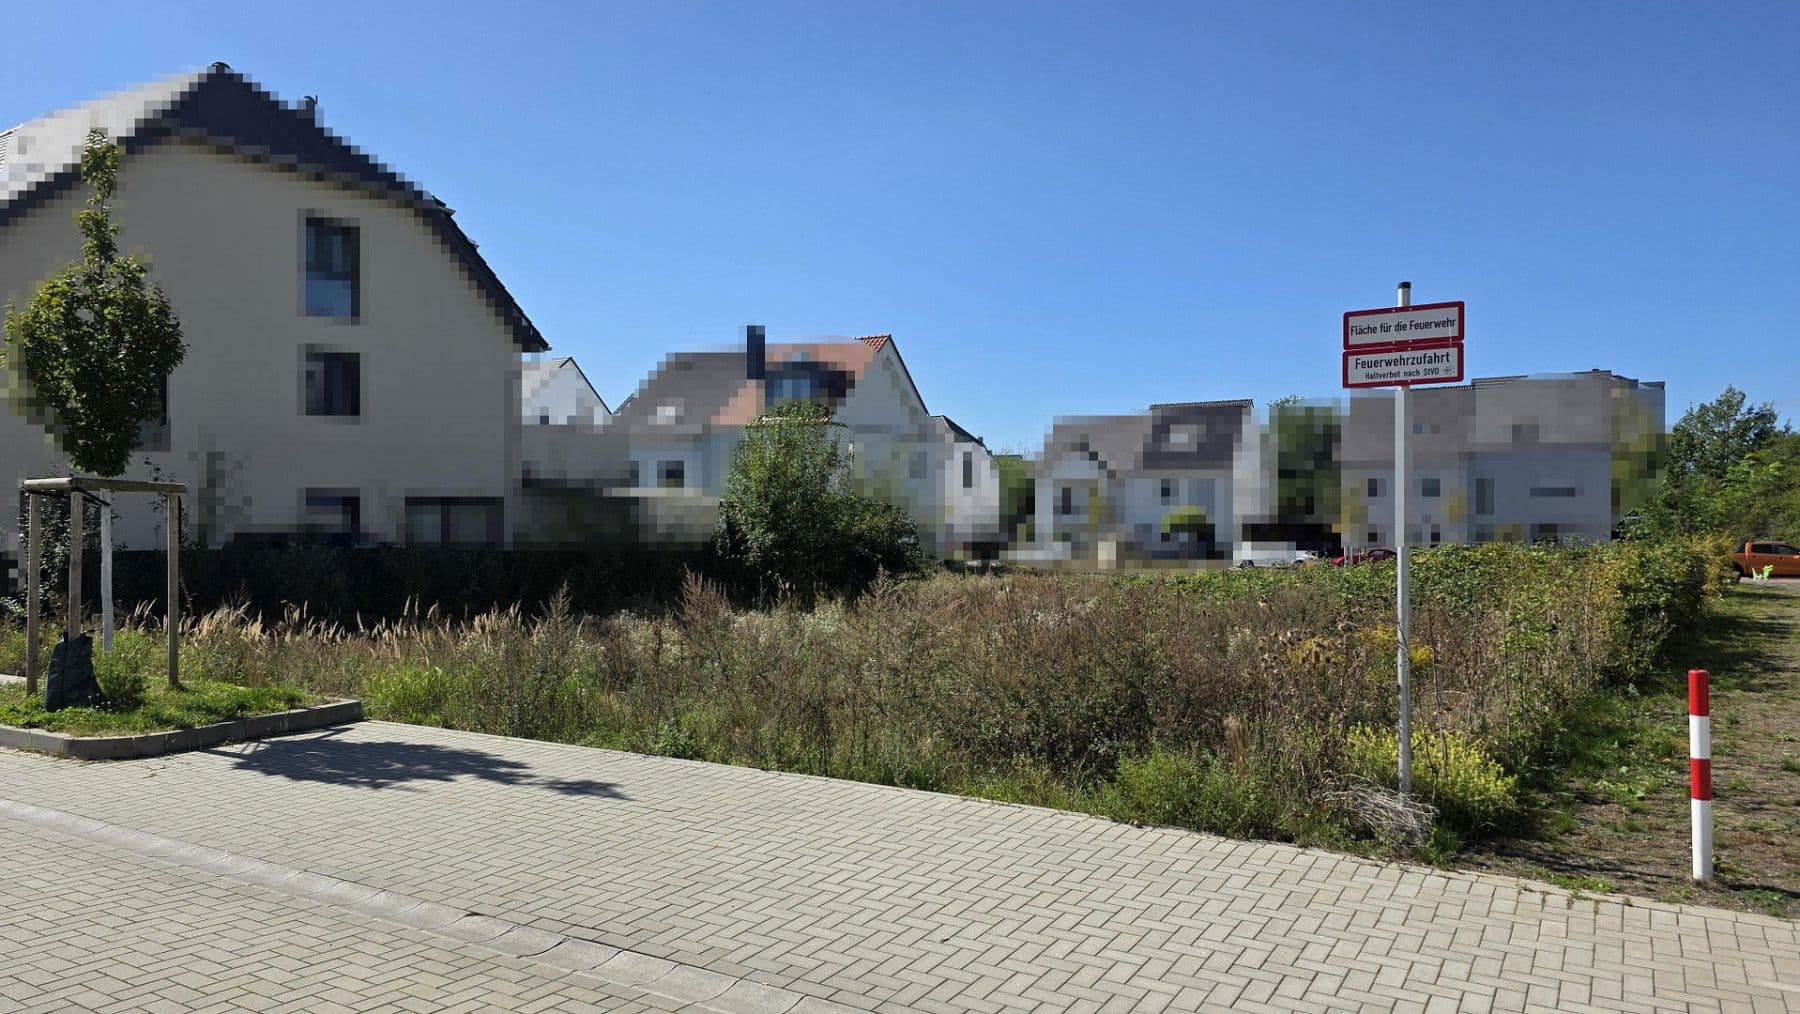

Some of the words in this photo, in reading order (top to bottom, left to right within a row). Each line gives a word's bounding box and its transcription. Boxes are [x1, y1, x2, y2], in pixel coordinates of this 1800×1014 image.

[1350, 324, 1378, 336] Fläche
[1380, 322, 1392, 333] für
[1394, 321, 1407, 332] die
[1409, 317, 1457, 331] Feuerwehr
[1355, 351, 1450, 370] Feuerwehrzufahrt
[1365, 370, 1401, 380] Haltverbot
[1403, 369, 1421, 377] nach
[1423, 367, 1440, 376] StVO
